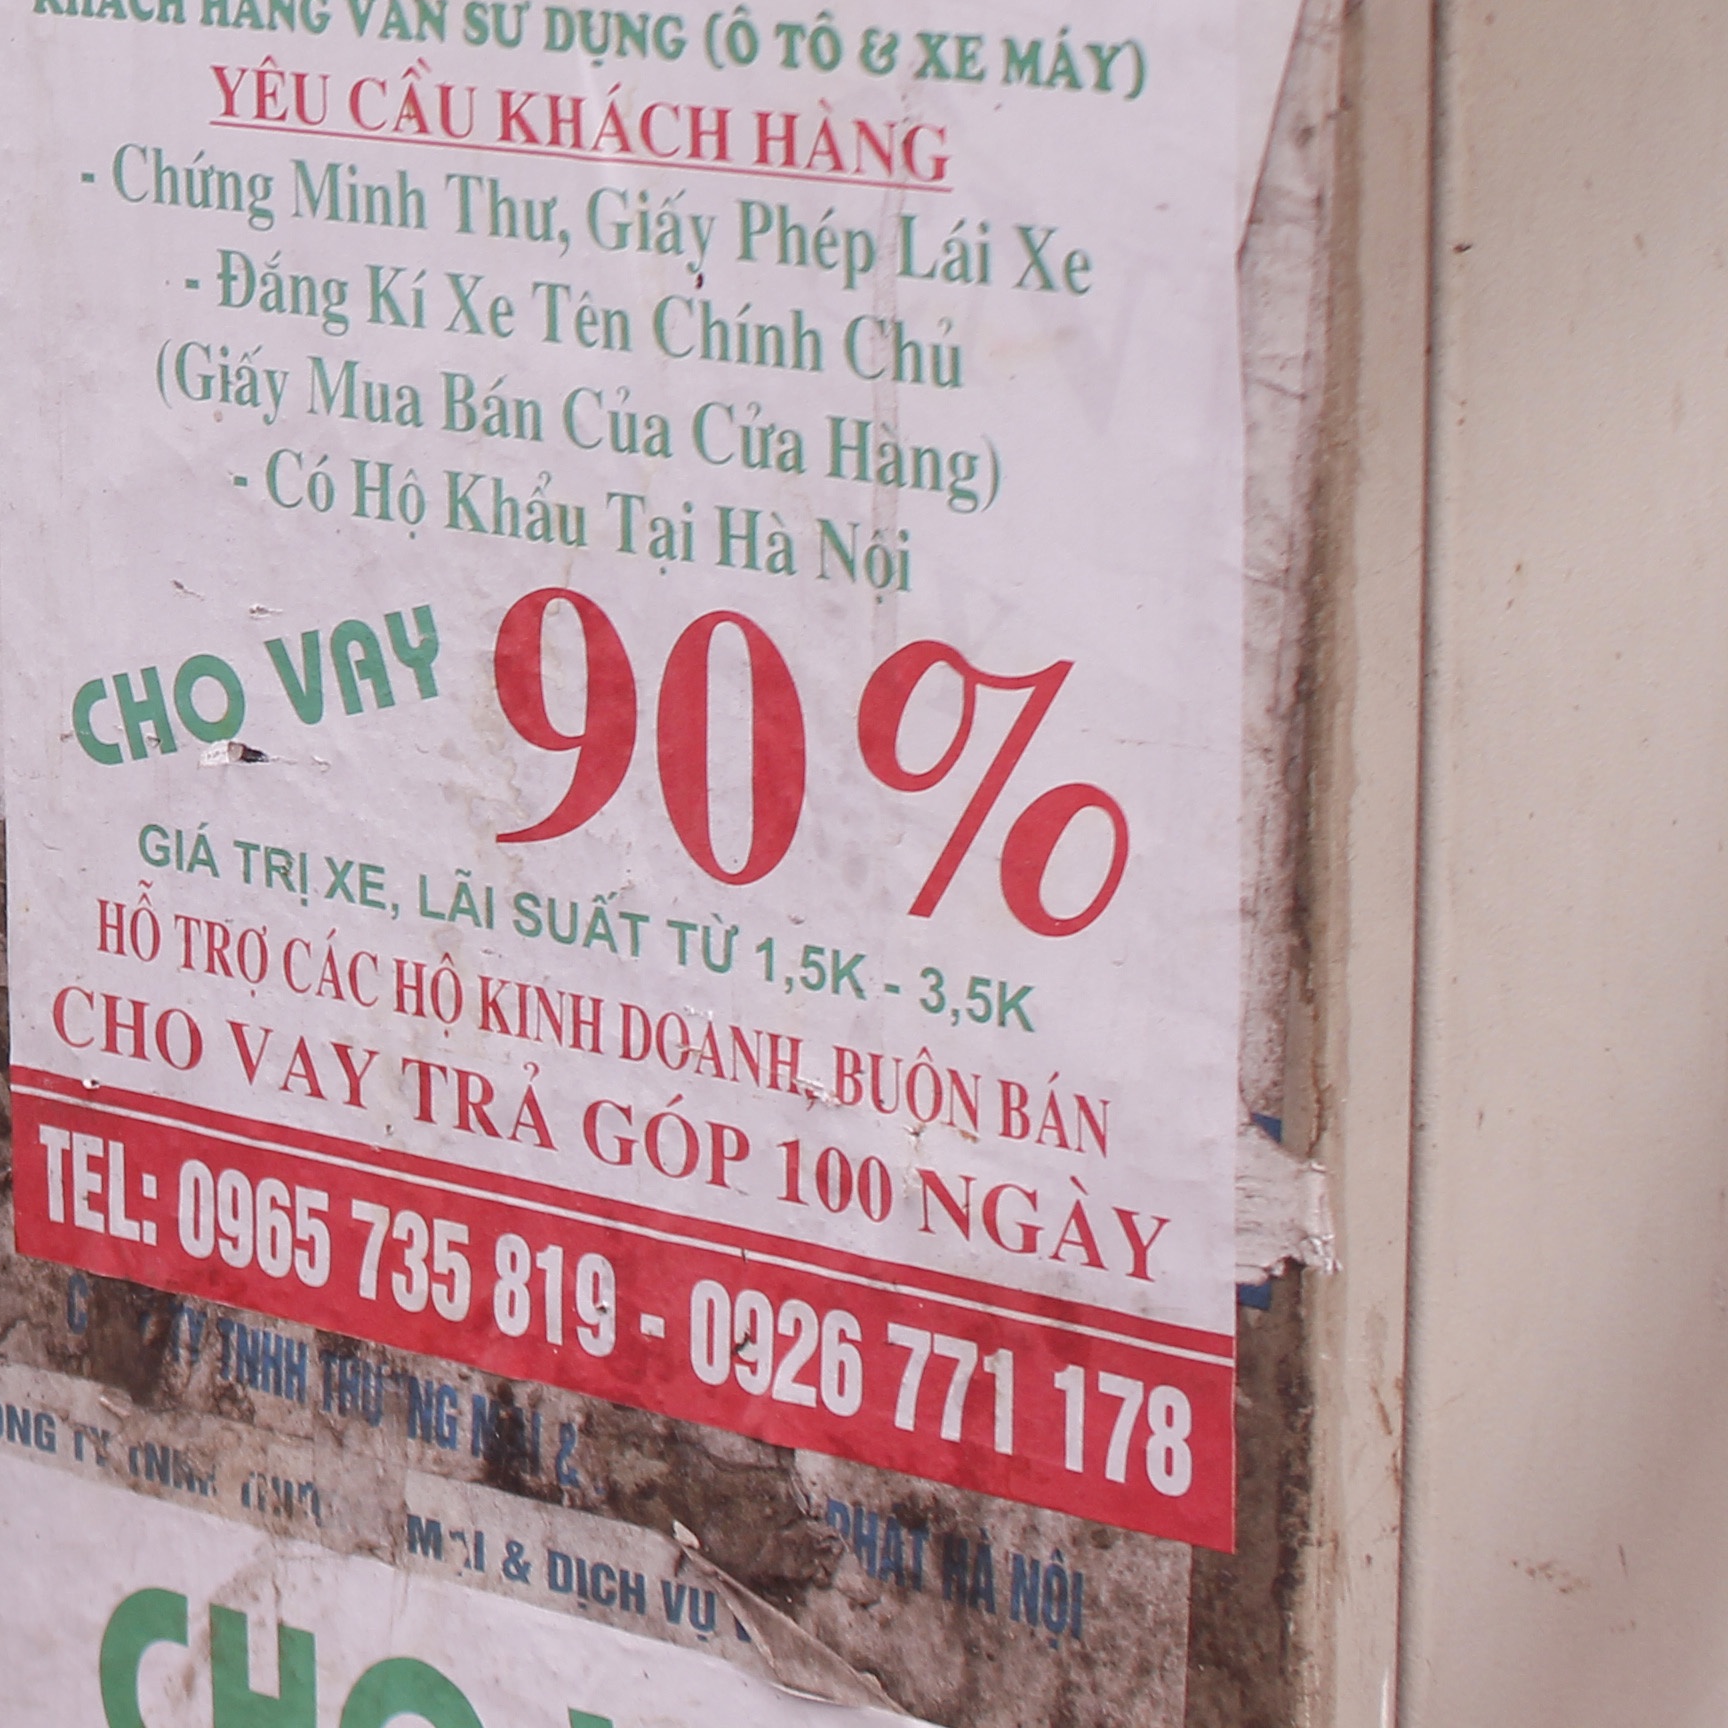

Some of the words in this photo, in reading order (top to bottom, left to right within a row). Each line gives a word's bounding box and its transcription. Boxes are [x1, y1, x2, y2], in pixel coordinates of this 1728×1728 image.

[209, 55, 329, 127] YÊU
[348, 58, 477, 139] CẦU
[496, 82, 732, 163] KHÁCH
[753, 98, 952, 182] HÀNG
[544, 4, 687, 68] DỤNG
[704, 4, 759, 70] (Ô
[773, 10, 843, 73] TÔ
[914, 32, 986, 84] XE
[1000, 26, 1147, 101] MÁY)
[111, 142, 275, 232] Chứng
[289, 158, 428, 230] Minh
[445, 172, 572, 258] Thư,
[586, 185, 716, 275] Giấy
[737, 197, 878, 290] Phép
[898, 214, 993, 285] Lái
[1012, 223, 1093, 295] Xe
[365, 263, 428, 330] Kí
[443, 271, 516, 339] Xe
[531, 279, 632, 352] Tên
[652, 293, 824, 373] Chính
[844, 312, 964, 389] Chủ
[155, 338, 289, 426] (Giấy
[305, 355, 424, 428] Mua
[440, 370, 545, 443] Bán
[561, 384, 673, 460] Của
[691, 400, 807, 474] Cửa
[825, 414, 1003, 514] Hàng)
[264, 447, 336, 514] Có
[350, 457, 427, 540] Hộ
[442, 470, 588, 548] Khẩu
[605, 491, 695, 576] Tại
[715, 504, 798, 577] Hà
[816, 517, 912, 605] Nội
[72, 652, 245, 766] CHO
[264, 604, 440, 727] VAY
[137, 822, 220, 880] GIÁ
[233, 839, 309, 907] TRỊ
[323, 854, 400, 921] XE,
[418, 867, 495, 930] LÃI
[511, 888, 650, 959] SUẤT
[666, 912, 740, 974] TỪ
[754, 936, 869, 1001] 1,5K
[917, 967, 1036, 1033] 3,5K
[97, 879, 162, 963] HỖ
[173, 913, 270, 998] TRỢ
[282, 928, 379, 1009] CÁC
[392, 951, 464, 1039] HỘ
[477, 974, 605, 1055] KINH
[830, 1046, 982, 1133] BUÔN
[997, 1072, 1112, 1159] BÁN
[51, 985, 204, 1072] CHO
[225, 1019, 380, 1109] VAY
[401, 1061, 558, 1152] TRẢ
[581, 1093, 752, 1190] GÓP
[774, 1138, 894, 1223] 100
[916, 1175, 1171, 1284] NGÀY
[38, 1124, 159, 1247] TEL:
[177, 1159, 331, 1288] 0965
[349, 1198, 472, 1323] 735
[492, 1232, 617, 1358] 819
[690, 1279, 864, 1417] 0926
[886, 1321, 1015, 1455] 771
[1052, 1363, 1194, 1497] 178
[546, 1550, 647, 1617] DỊCH
